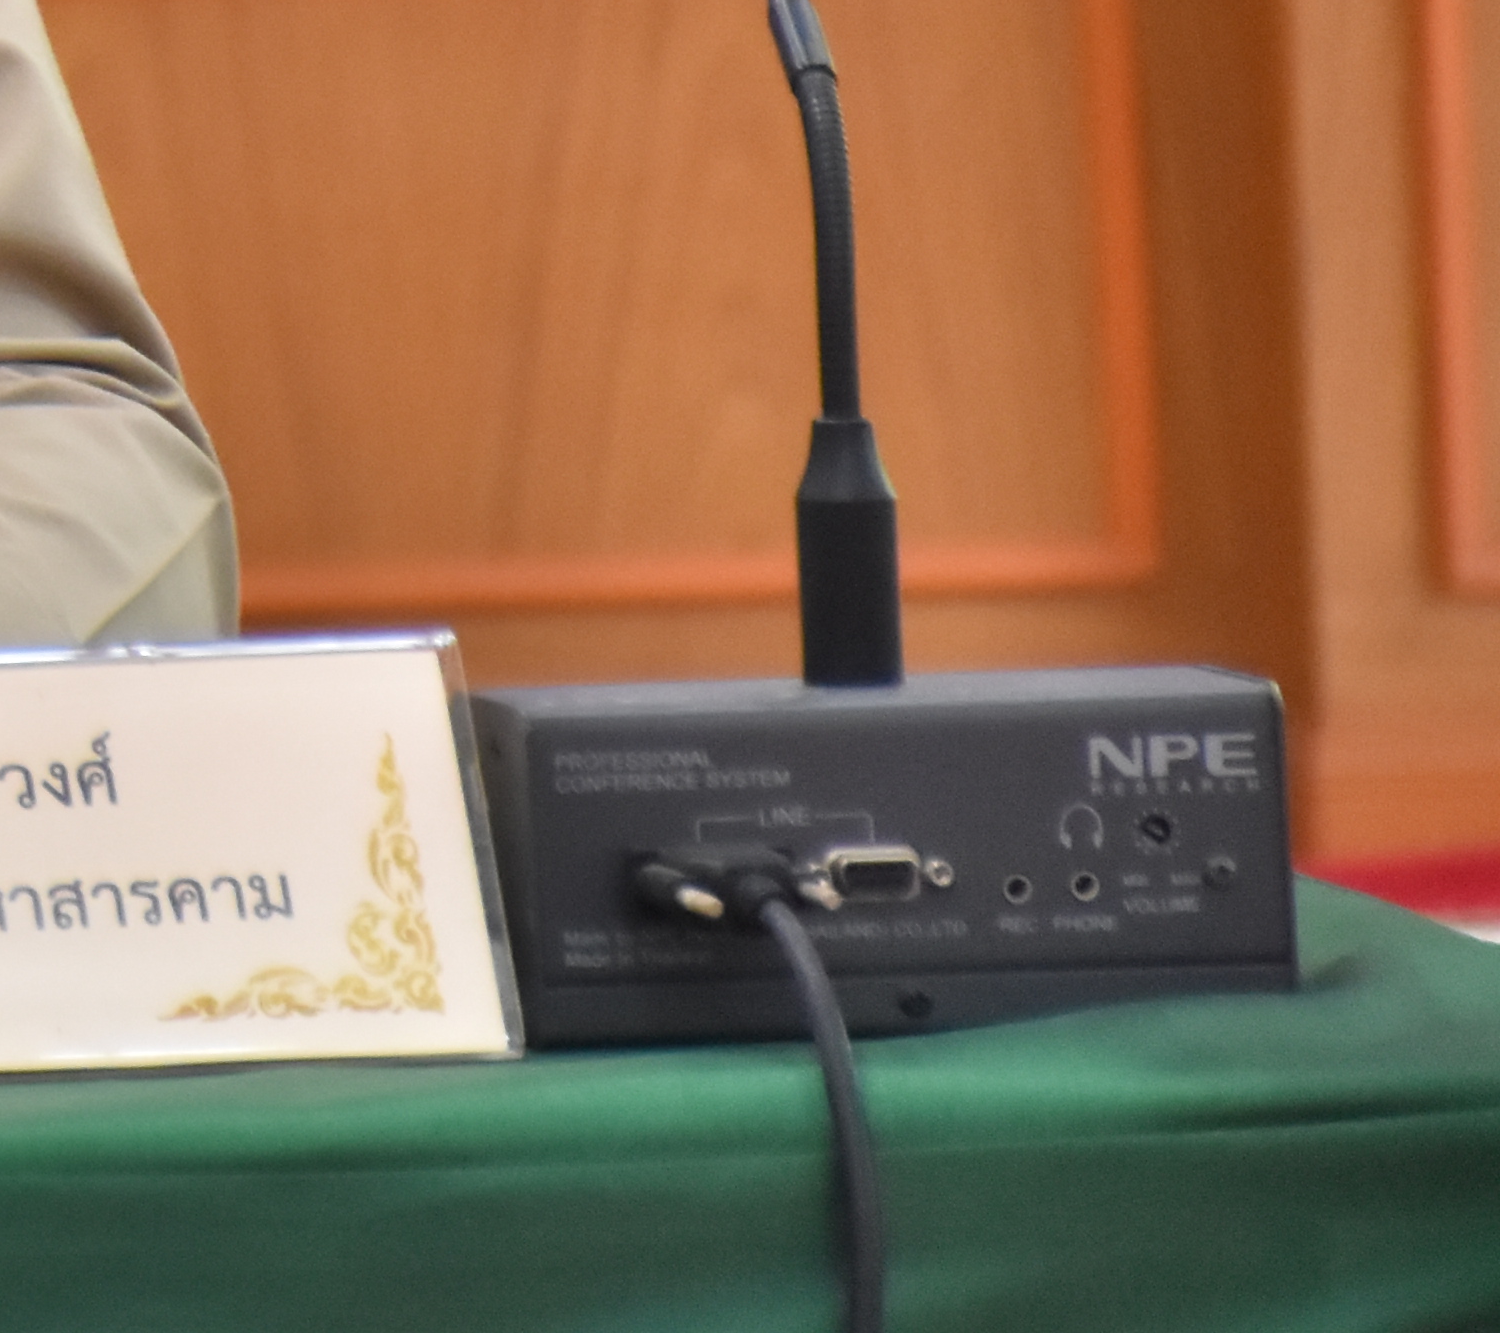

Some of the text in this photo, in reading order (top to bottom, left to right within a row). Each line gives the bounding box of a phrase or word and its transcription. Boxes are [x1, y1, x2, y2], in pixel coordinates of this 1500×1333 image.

[1087, 731, 1258, 779] NPE
[705, 768, 791, 789] SYSTEM
[757, 804, 811, 828] LINE
